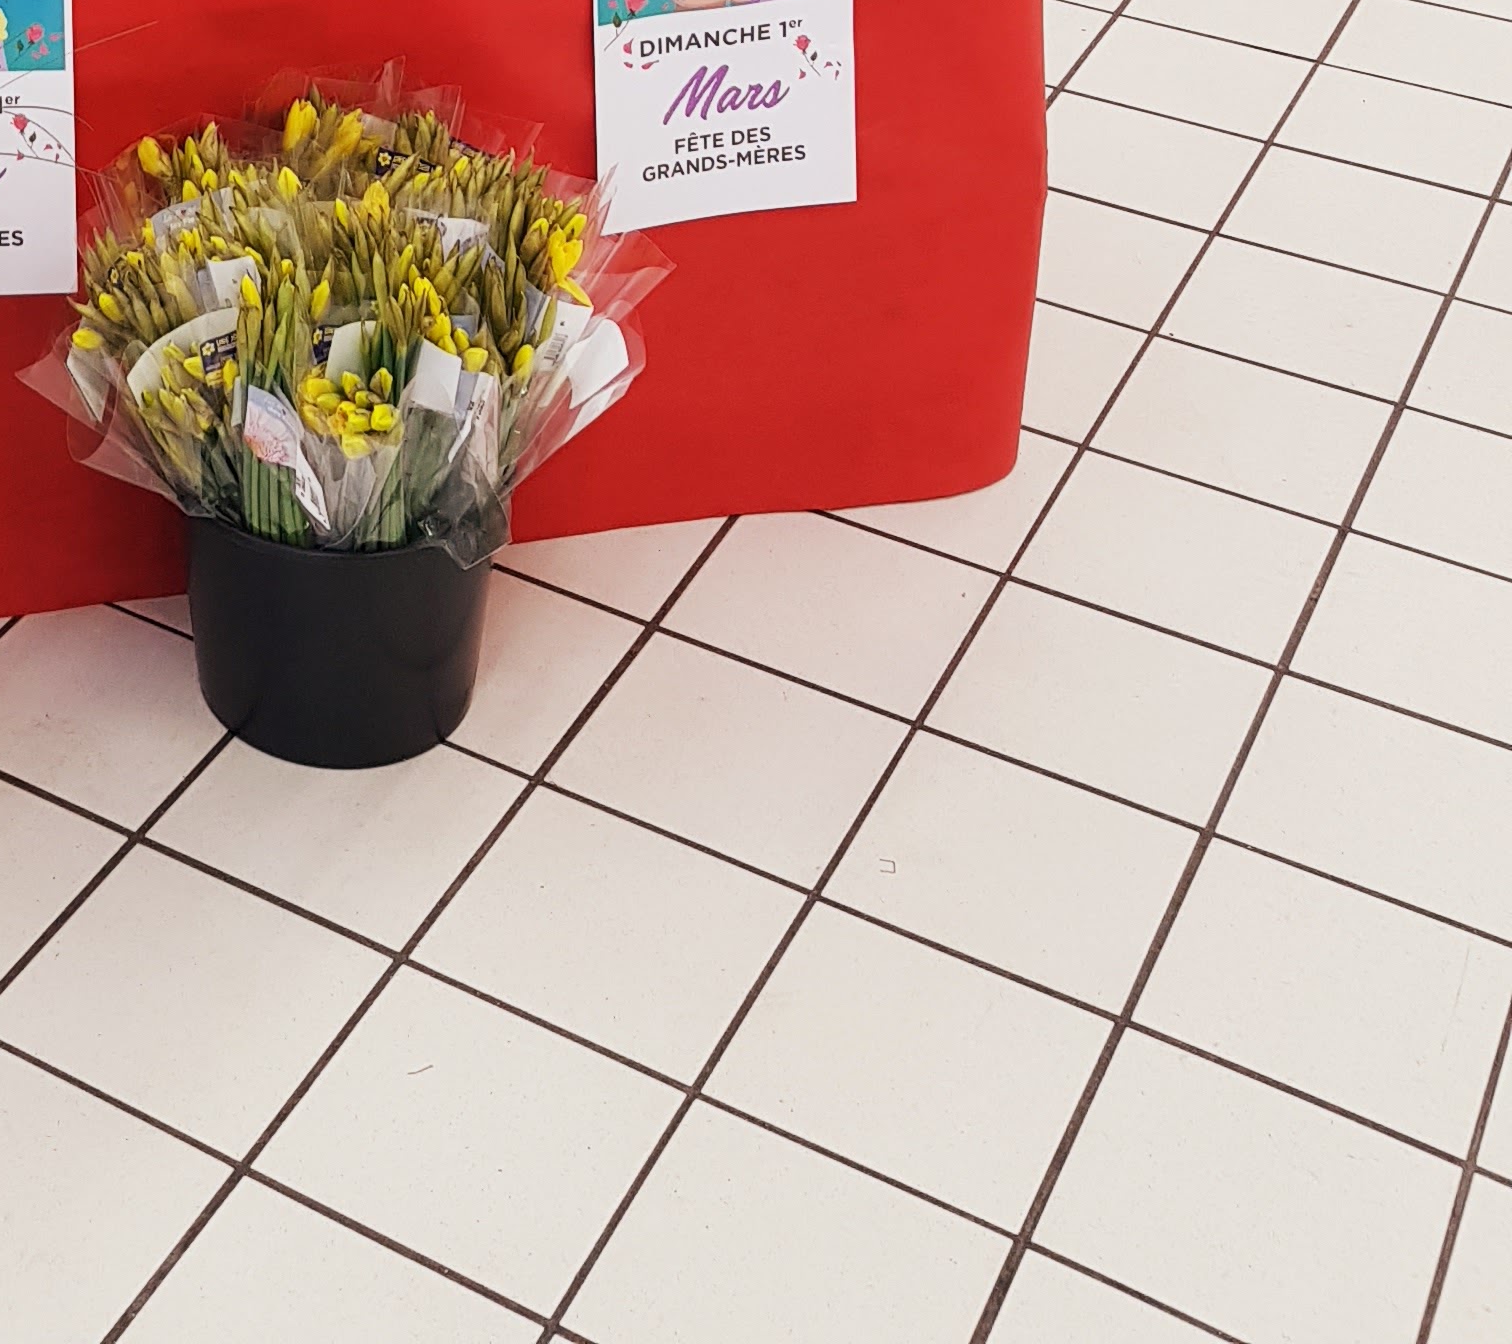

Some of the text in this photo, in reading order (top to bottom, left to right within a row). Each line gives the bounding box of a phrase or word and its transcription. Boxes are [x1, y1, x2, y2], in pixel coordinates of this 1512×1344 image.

[639, 19, 803, 58] DIMANCHE 1er
[662, 64, 790, 125] Mars
[674, 126, 771, 155] FÊTE DES
[642, 145, 807, 182] GRANDS-MÈRES
